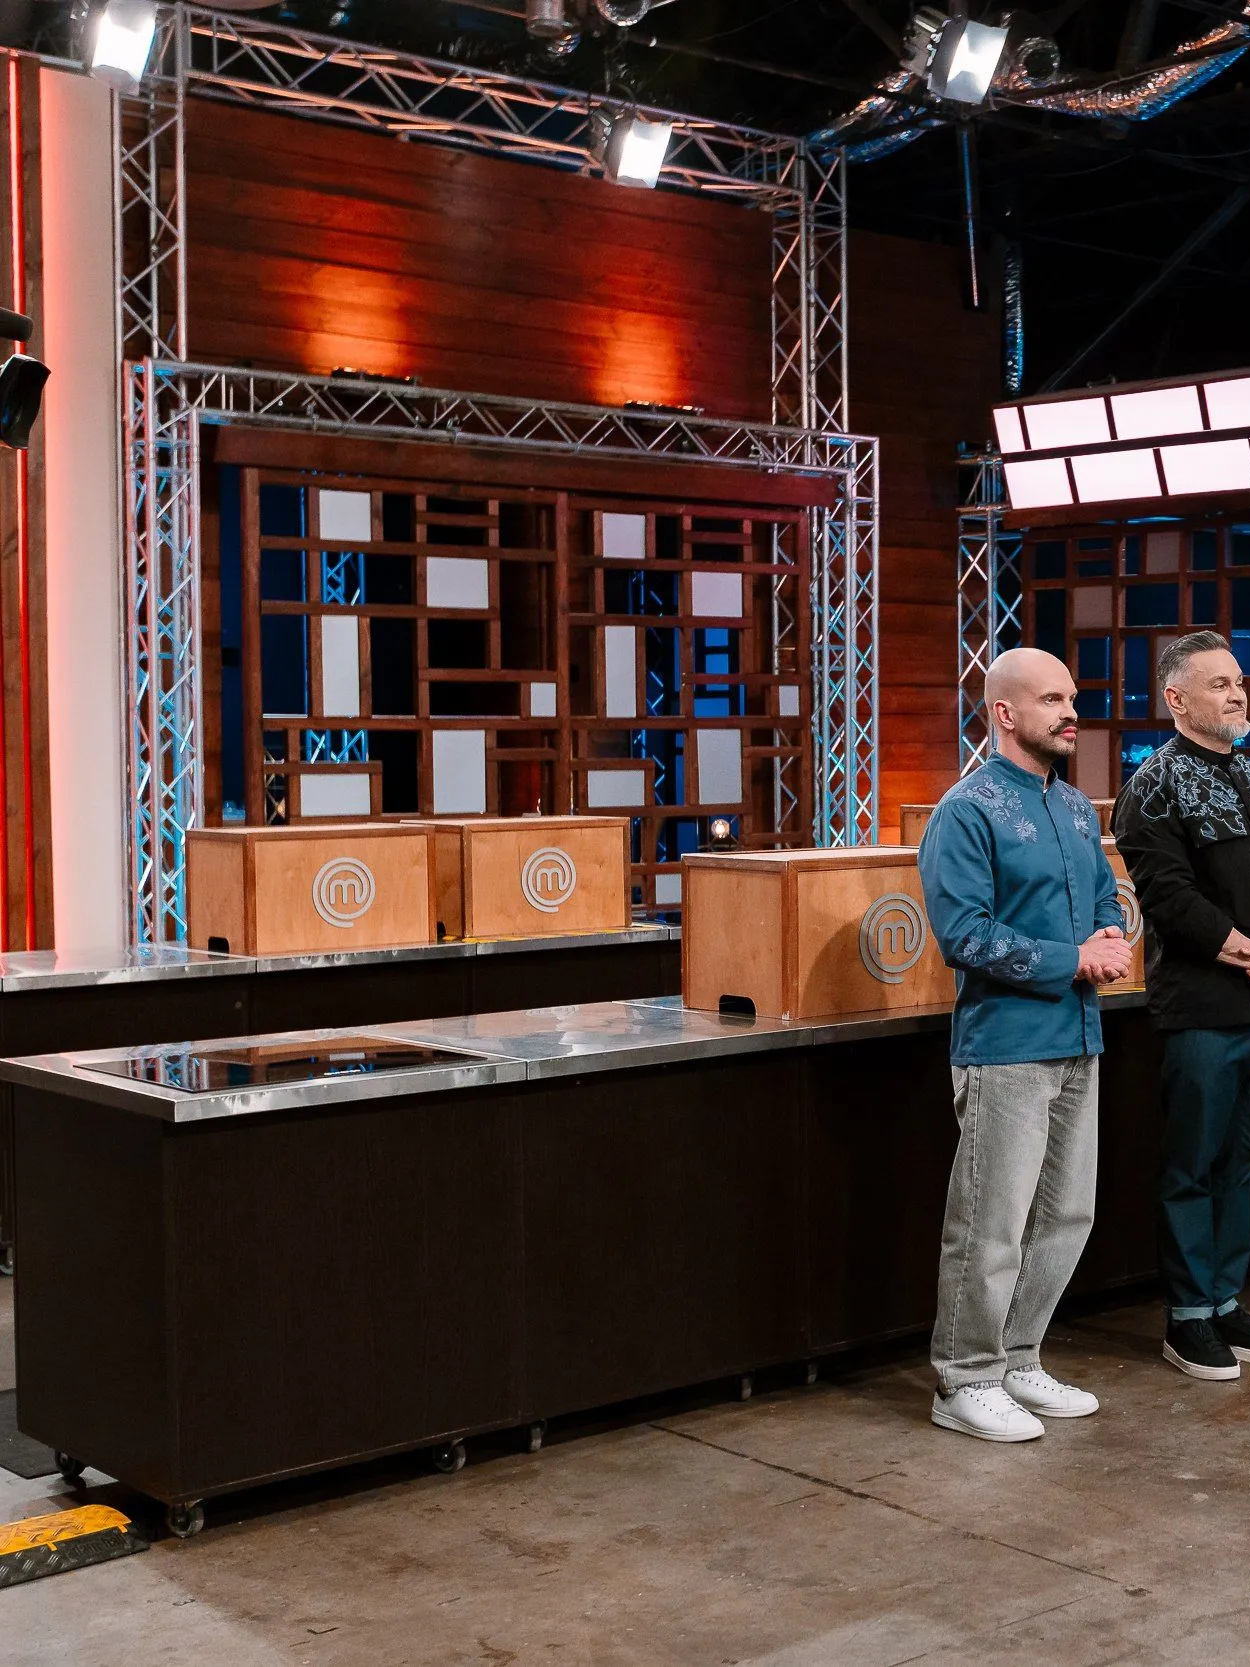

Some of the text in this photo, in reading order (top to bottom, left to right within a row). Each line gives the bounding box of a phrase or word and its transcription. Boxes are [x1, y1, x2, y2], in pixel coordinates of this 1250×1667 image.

[329, 879, 363, 904] m
[535, 867, 567, 891] m
[878, 920, 914, 954] m
